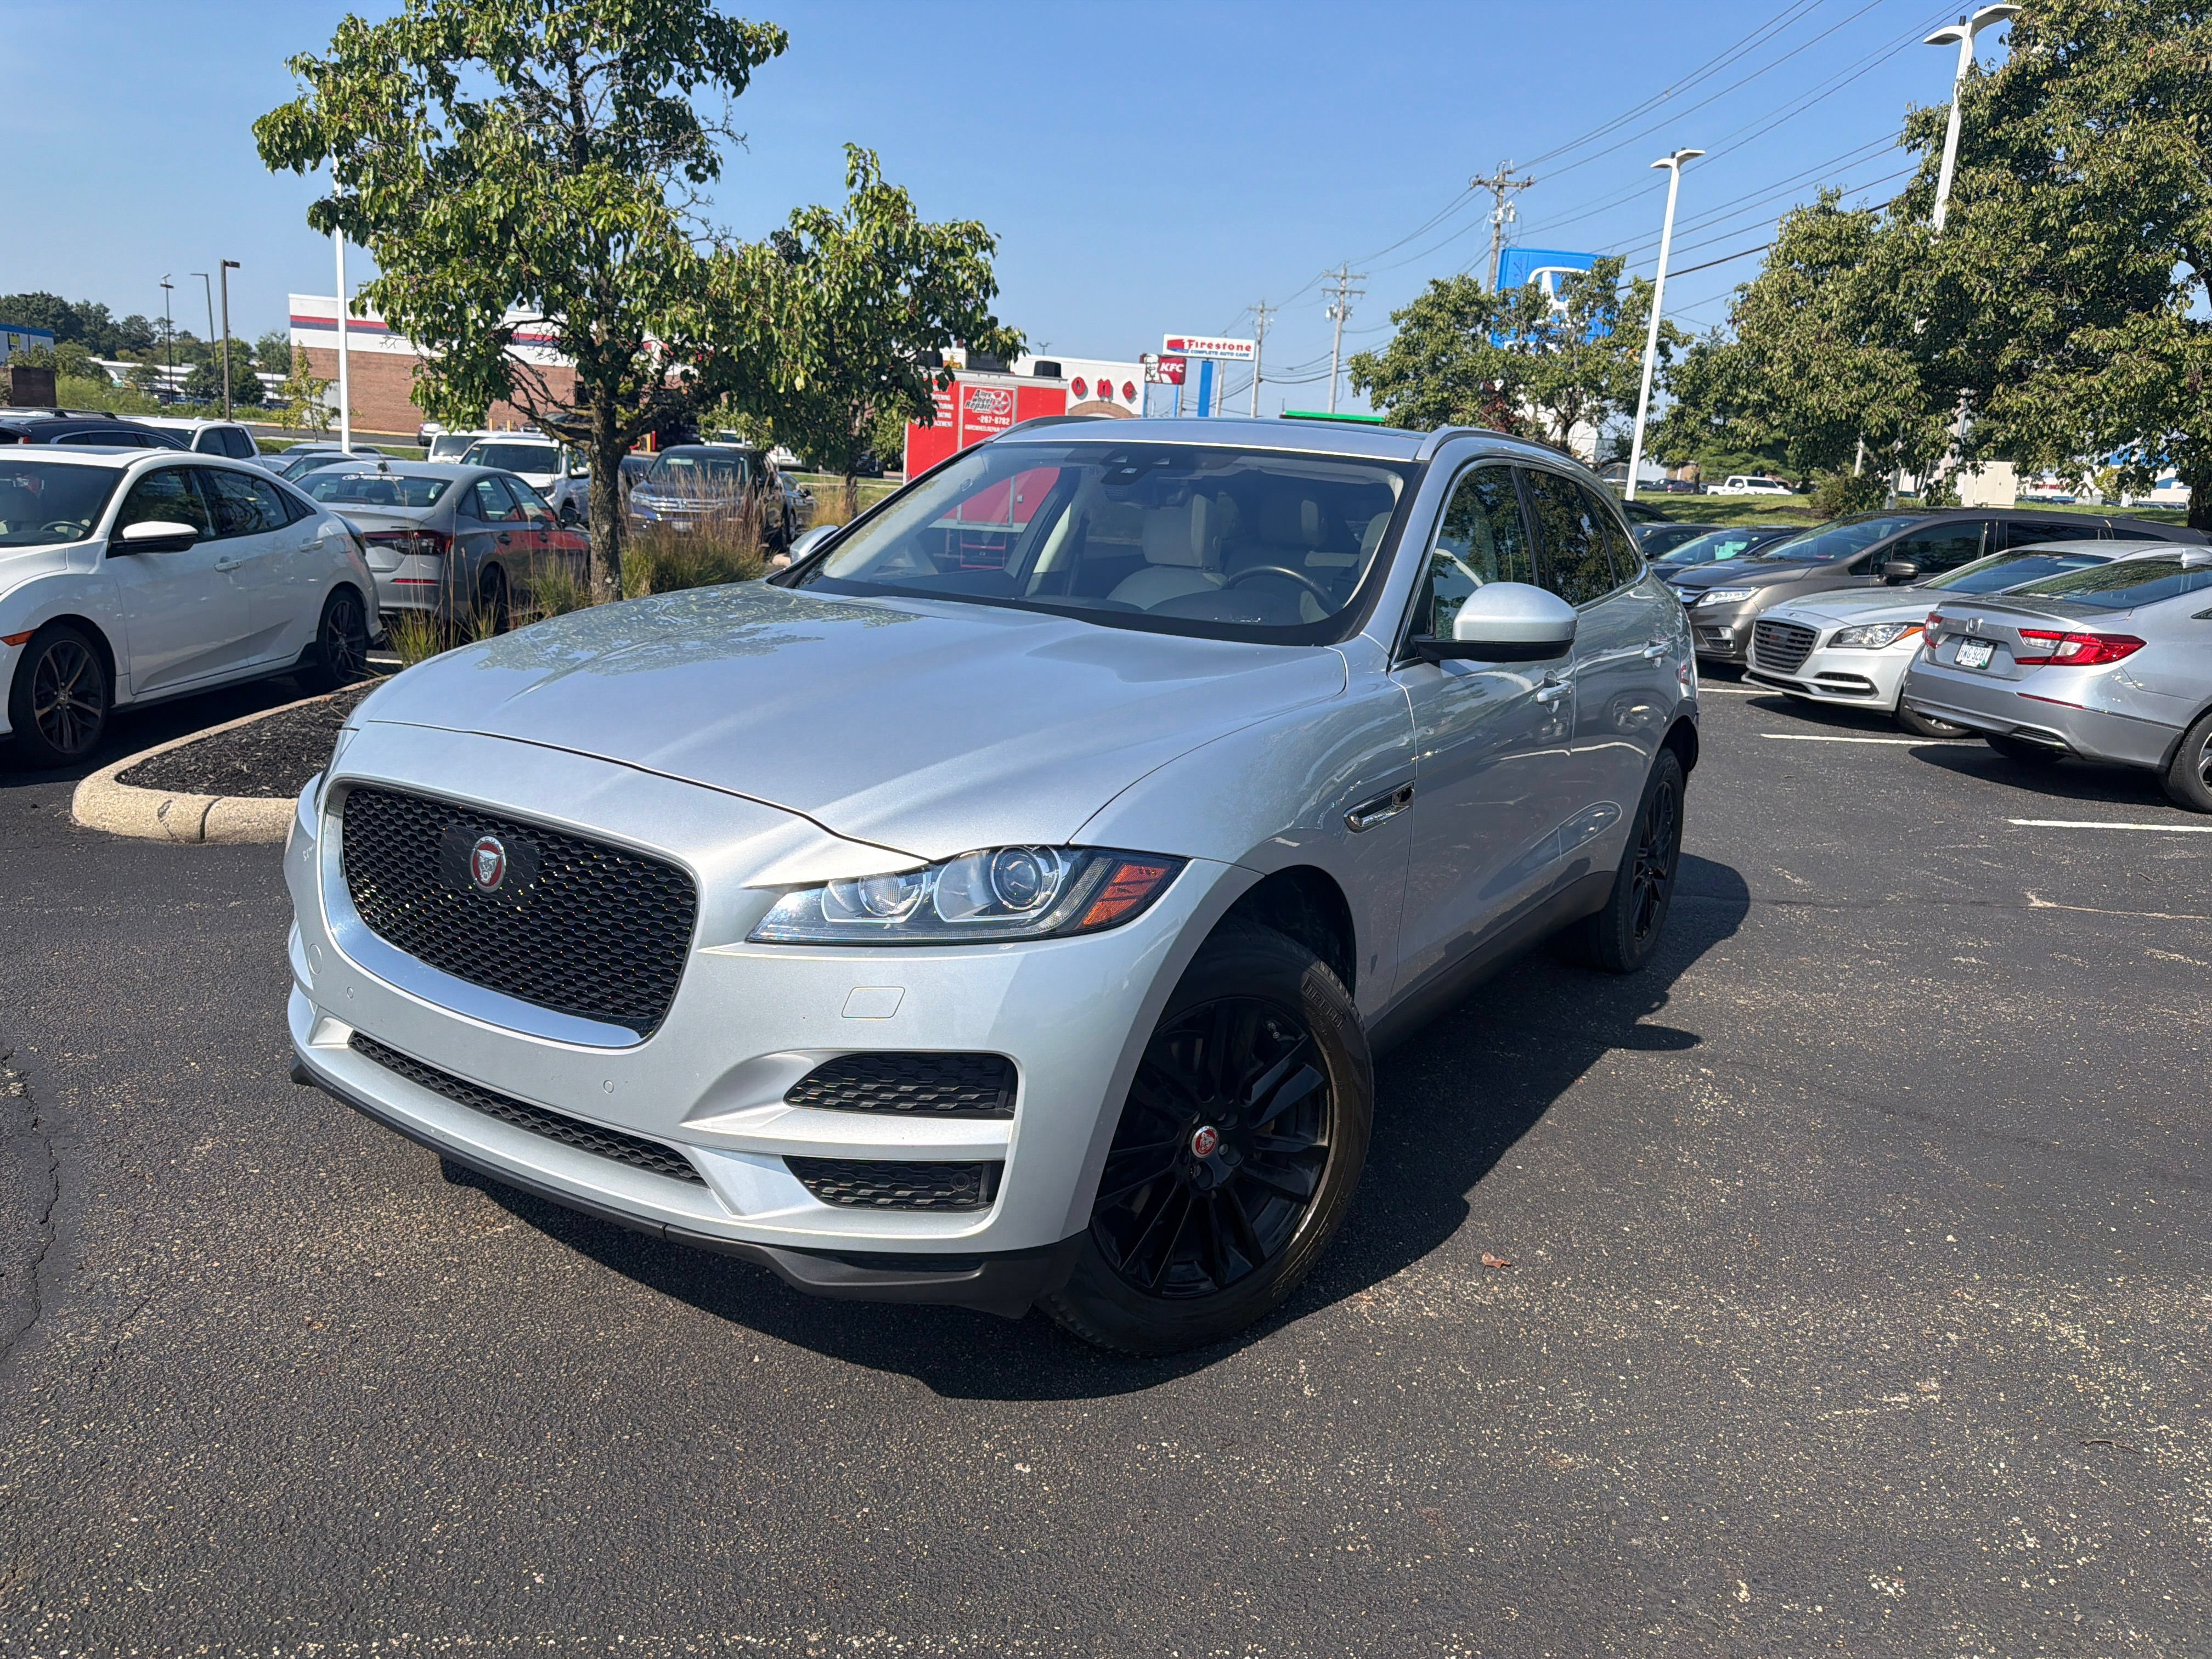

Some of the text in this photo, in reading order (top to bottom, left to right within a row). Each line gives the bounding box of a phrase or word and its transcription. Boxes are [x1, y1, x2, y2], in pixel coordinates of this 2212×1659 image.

[1187, 339, 1251, 352] Firestone
[1160, 363, 1184, 373] KFC
[965, 401, 991, 410] Repair
[1972, 648, 1989, 661] 9281
